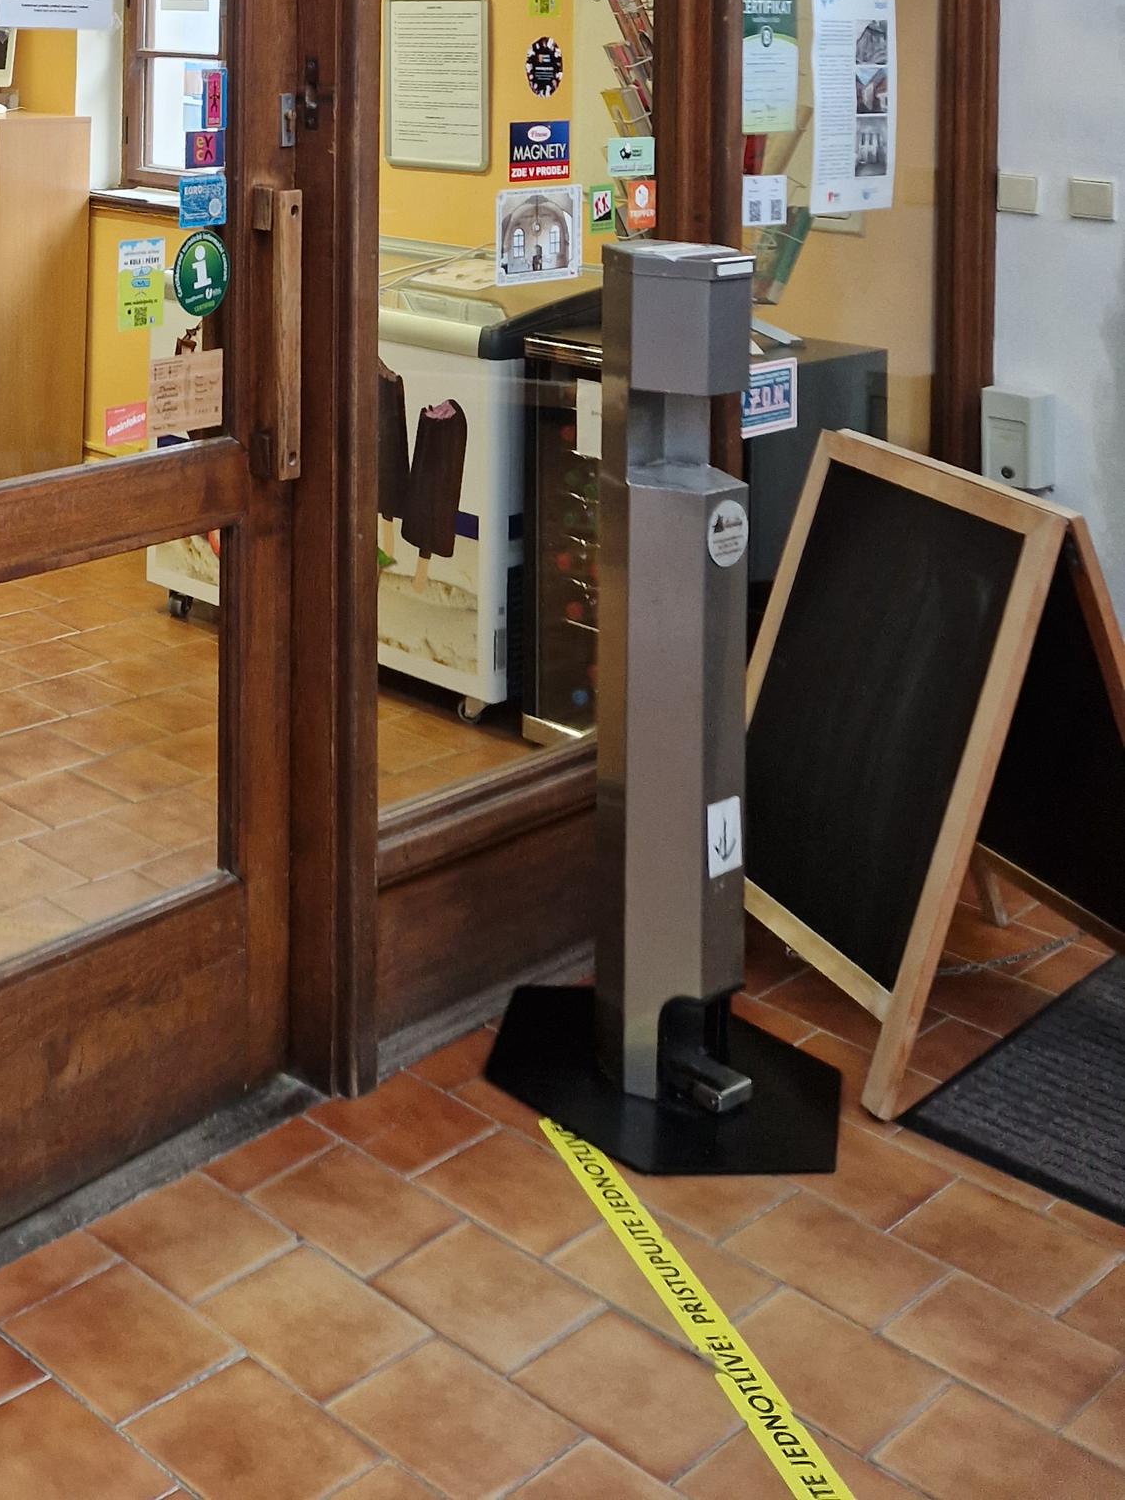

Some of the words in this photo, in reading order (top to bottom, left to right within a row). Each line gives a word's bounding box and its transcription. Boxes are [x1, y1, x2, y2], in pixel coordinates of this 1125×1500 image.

[513, 143, 566, 161] MAGNETY
[511, 167, 528, 178] ZDE
[528, 167, 535, 177] V
